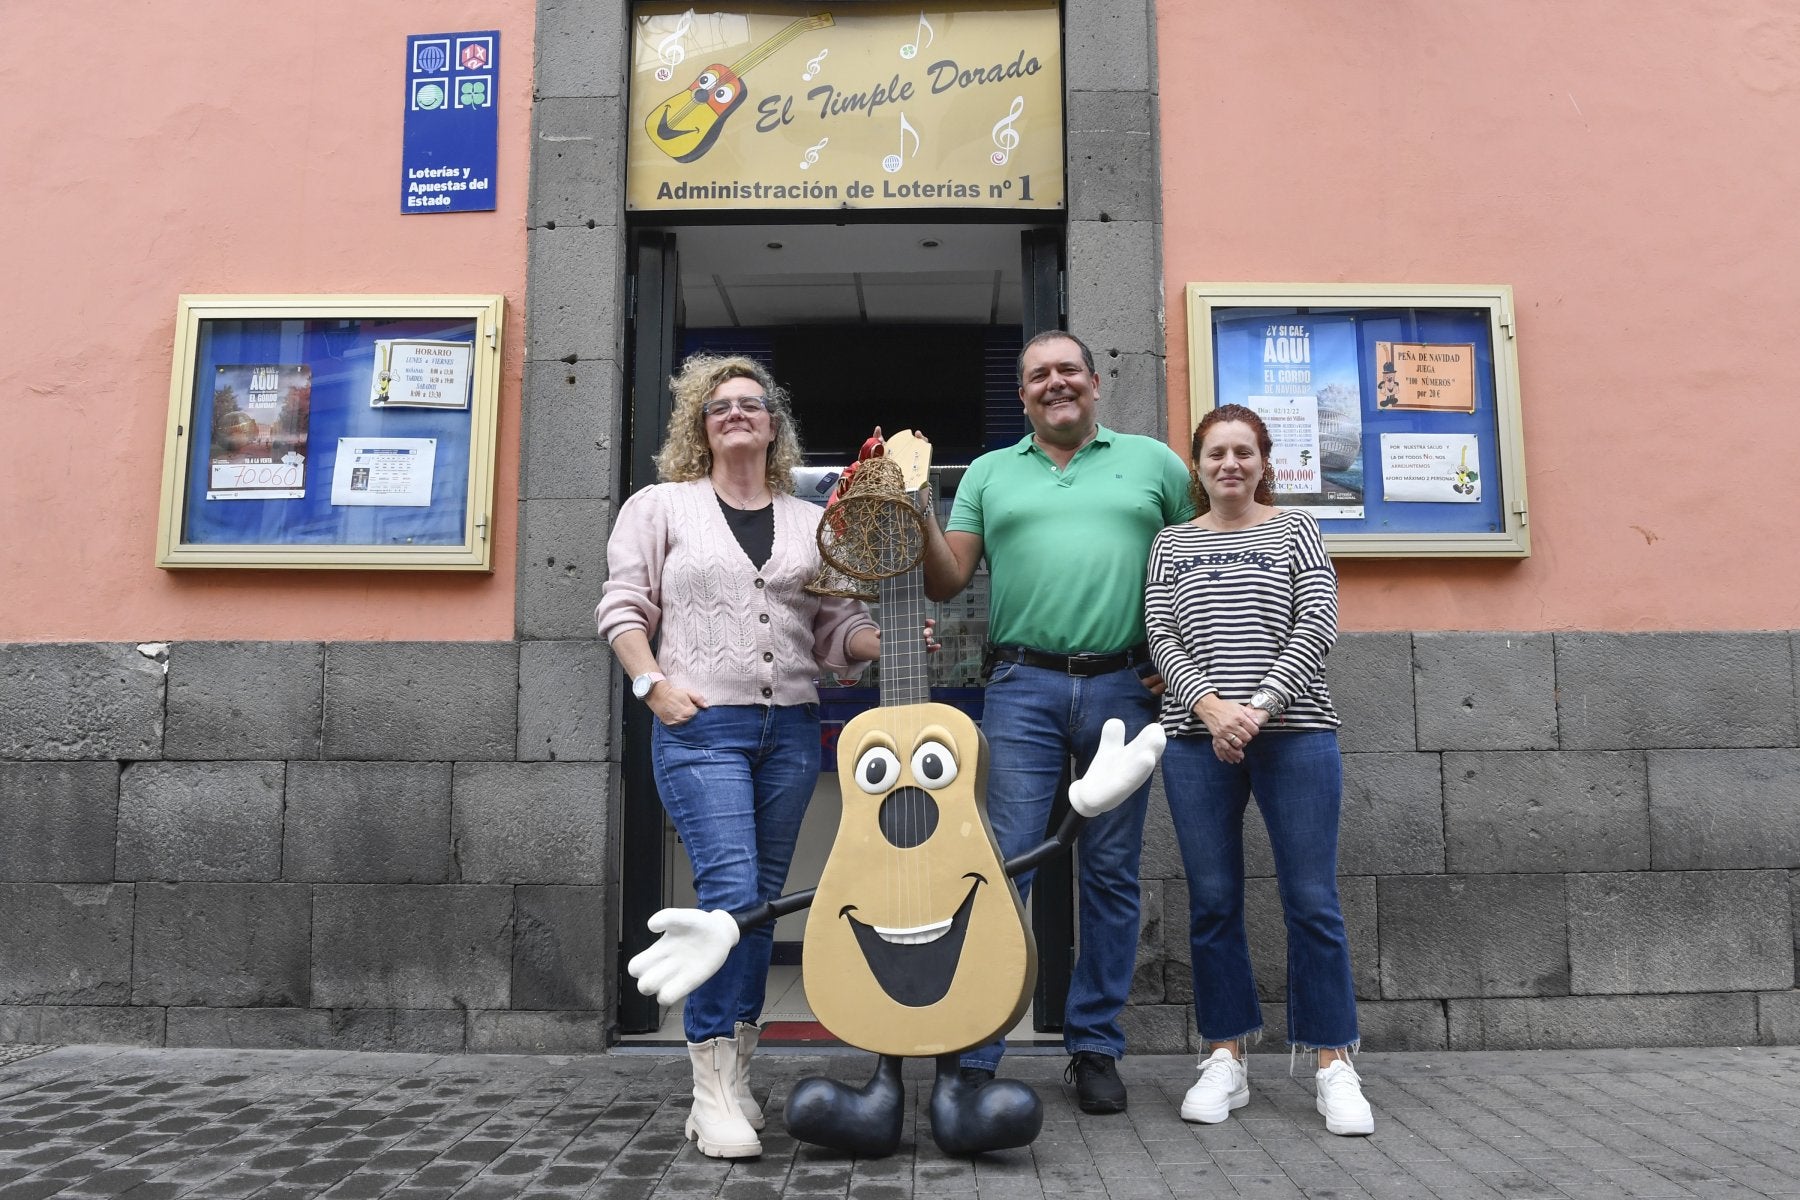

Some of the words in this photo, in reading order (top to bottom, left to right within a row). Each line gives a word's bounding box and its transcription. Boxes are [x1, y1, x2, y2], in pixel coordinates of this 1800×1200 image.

[755, 94, 795, 133] El
[806, 73, 915, 119] Timple
[926, 49, 1042, 95] Dorado
[408, 166, 460, 179] Loterías
[462, 167, 471, 179] y
[408, 180, 467, 195] Apuestas
[468, 178, 489, 190] del
[656, 181, 838, 200] Administración
[846, 180, 875, 198] de
[883, 179, 981, 198] Loterías
[989, 180, 1012, 198] nº
[1018, 174, 1034, 201] 1
[407, 194, 451, 207] Estado
[1279, 325, 1287, 336] SI
[1288, 325, 1304, 337] CAE
[415, 347, 452, 357] HORARIO
[1263, 332, 1311, 364] AQUÍ
[1398, 350, 1416, 361] PEÑA
[1418, 353, 1428, 362] DE
[1429, 353, 1460, 362] NAVIDAD
[1416, 364, 1435, 373] JUEGA
[1264, 369, 1276, 383] EL
[1278, 369, 1311, 384] GORDO
[1416, 390, 1426, 399] por
[229, 465, 298, 487] 70060
